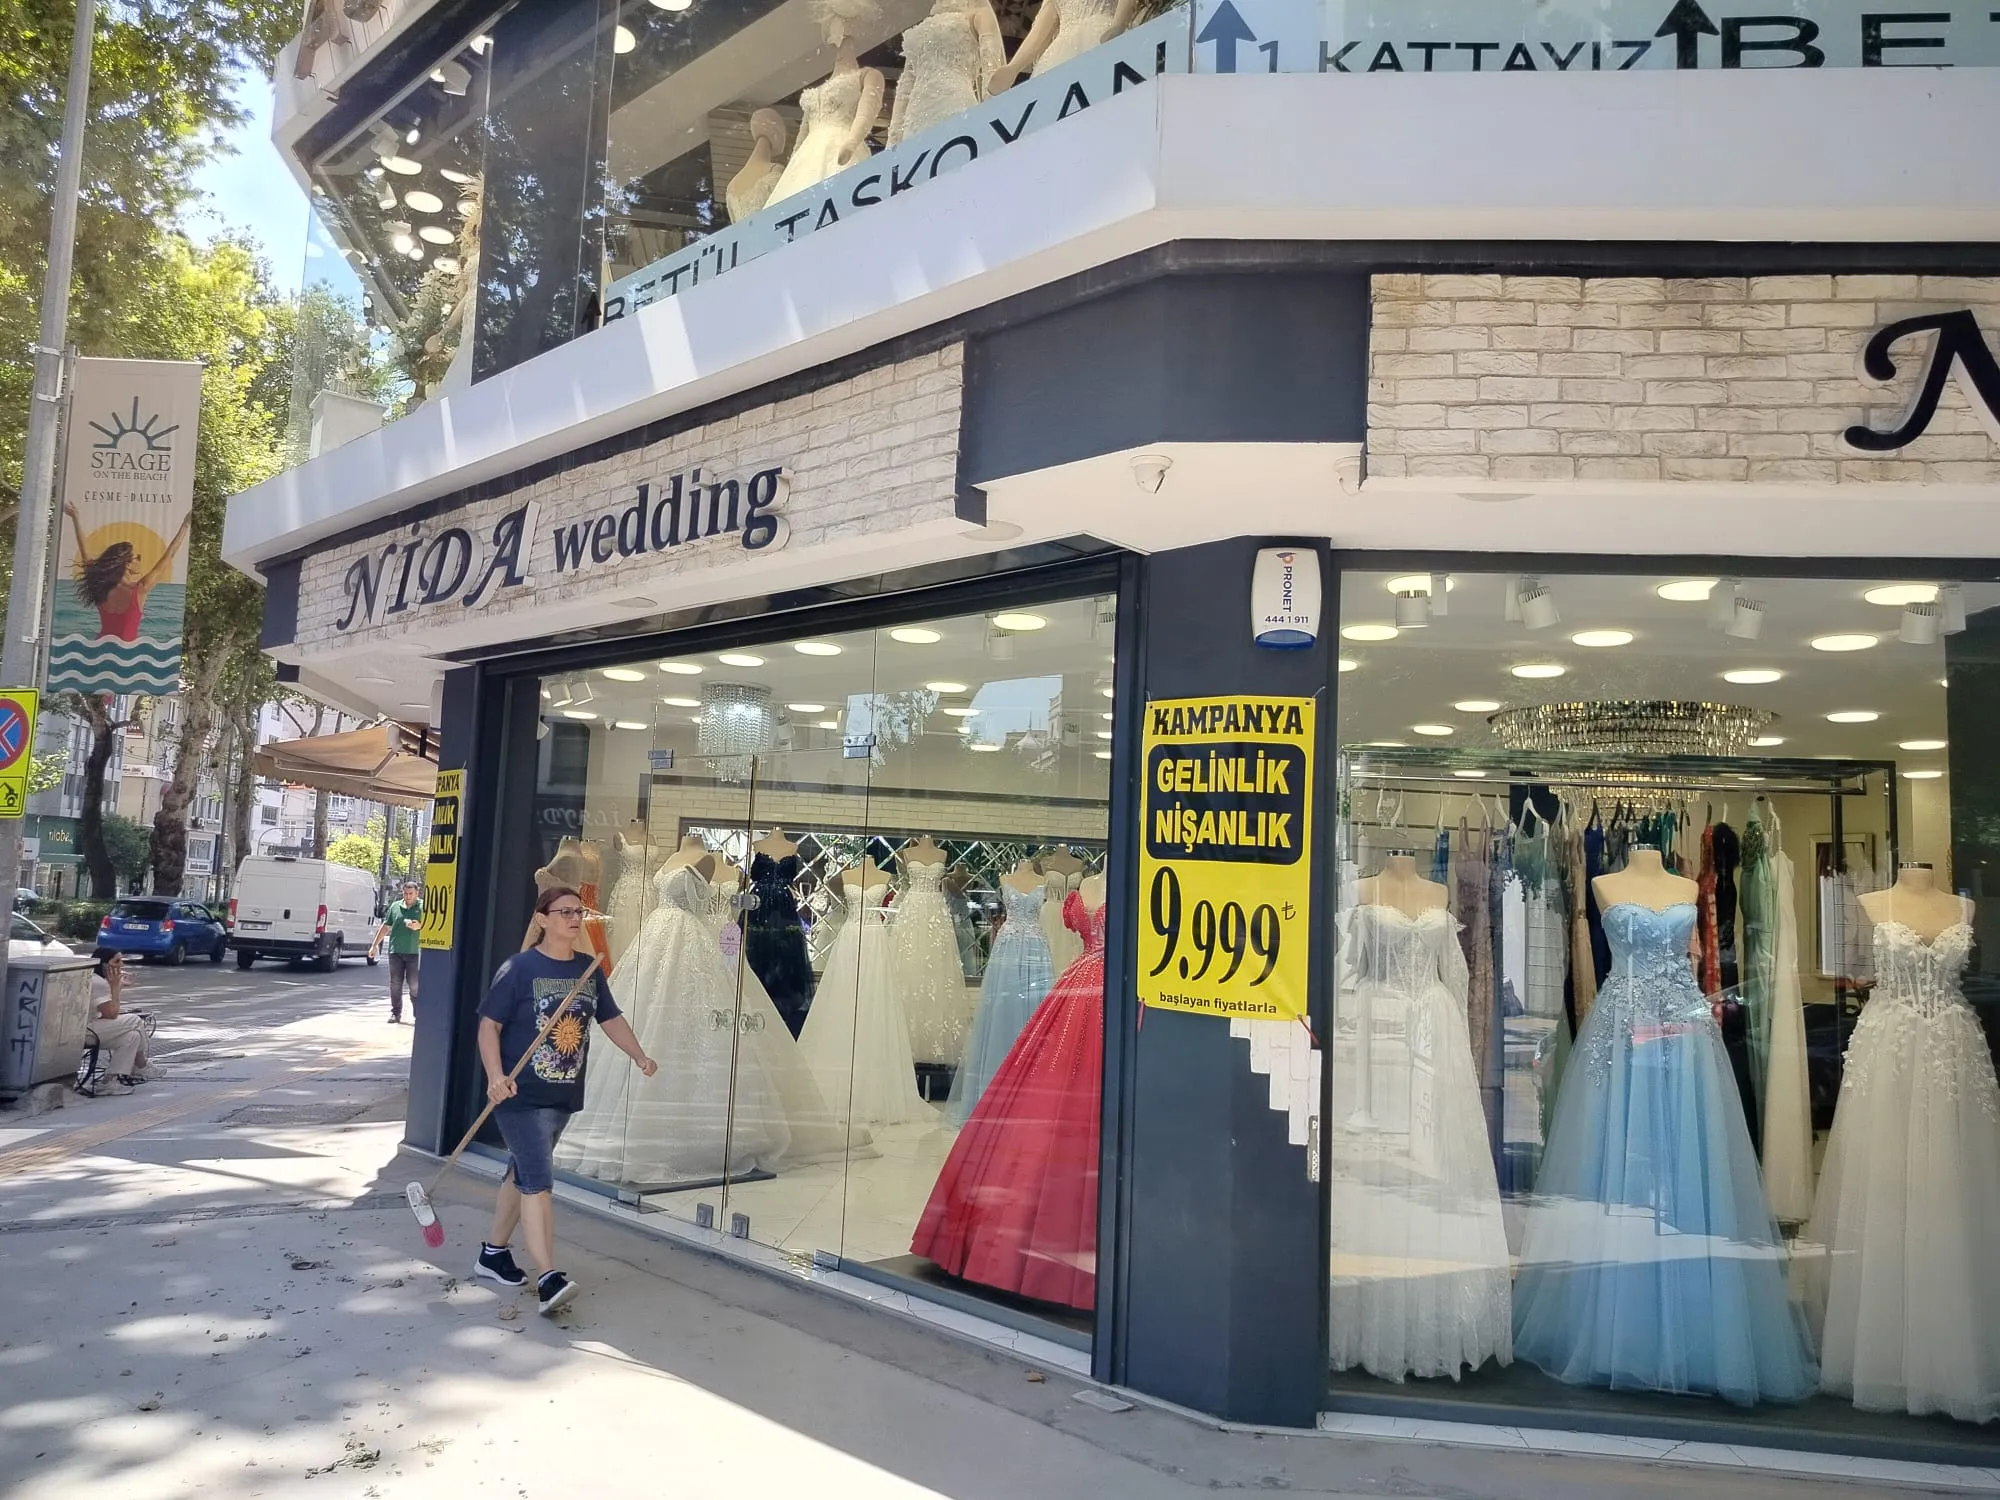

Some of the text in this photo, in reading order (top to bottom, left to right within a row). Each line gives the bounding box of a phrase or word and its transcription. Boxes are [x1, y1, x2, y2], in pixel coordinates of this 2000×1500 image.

[1722, 12, 2000, 68] BE
[91, 451, 171, 471] STAGE
[93, 471, 109, 479] ON
[337, 467, 783, 632] NİDA wedding
[1283, 566, 1292, 612] PRONET
[1152, 704, 1304, 736] KAMPANYA
[1157, 750, 1290, 795] GELİNLİK
[1155, 801, 1292, 853] NİŞANLIK
[1160, 991, 1277, 1014] başlayan fiyatlarla
